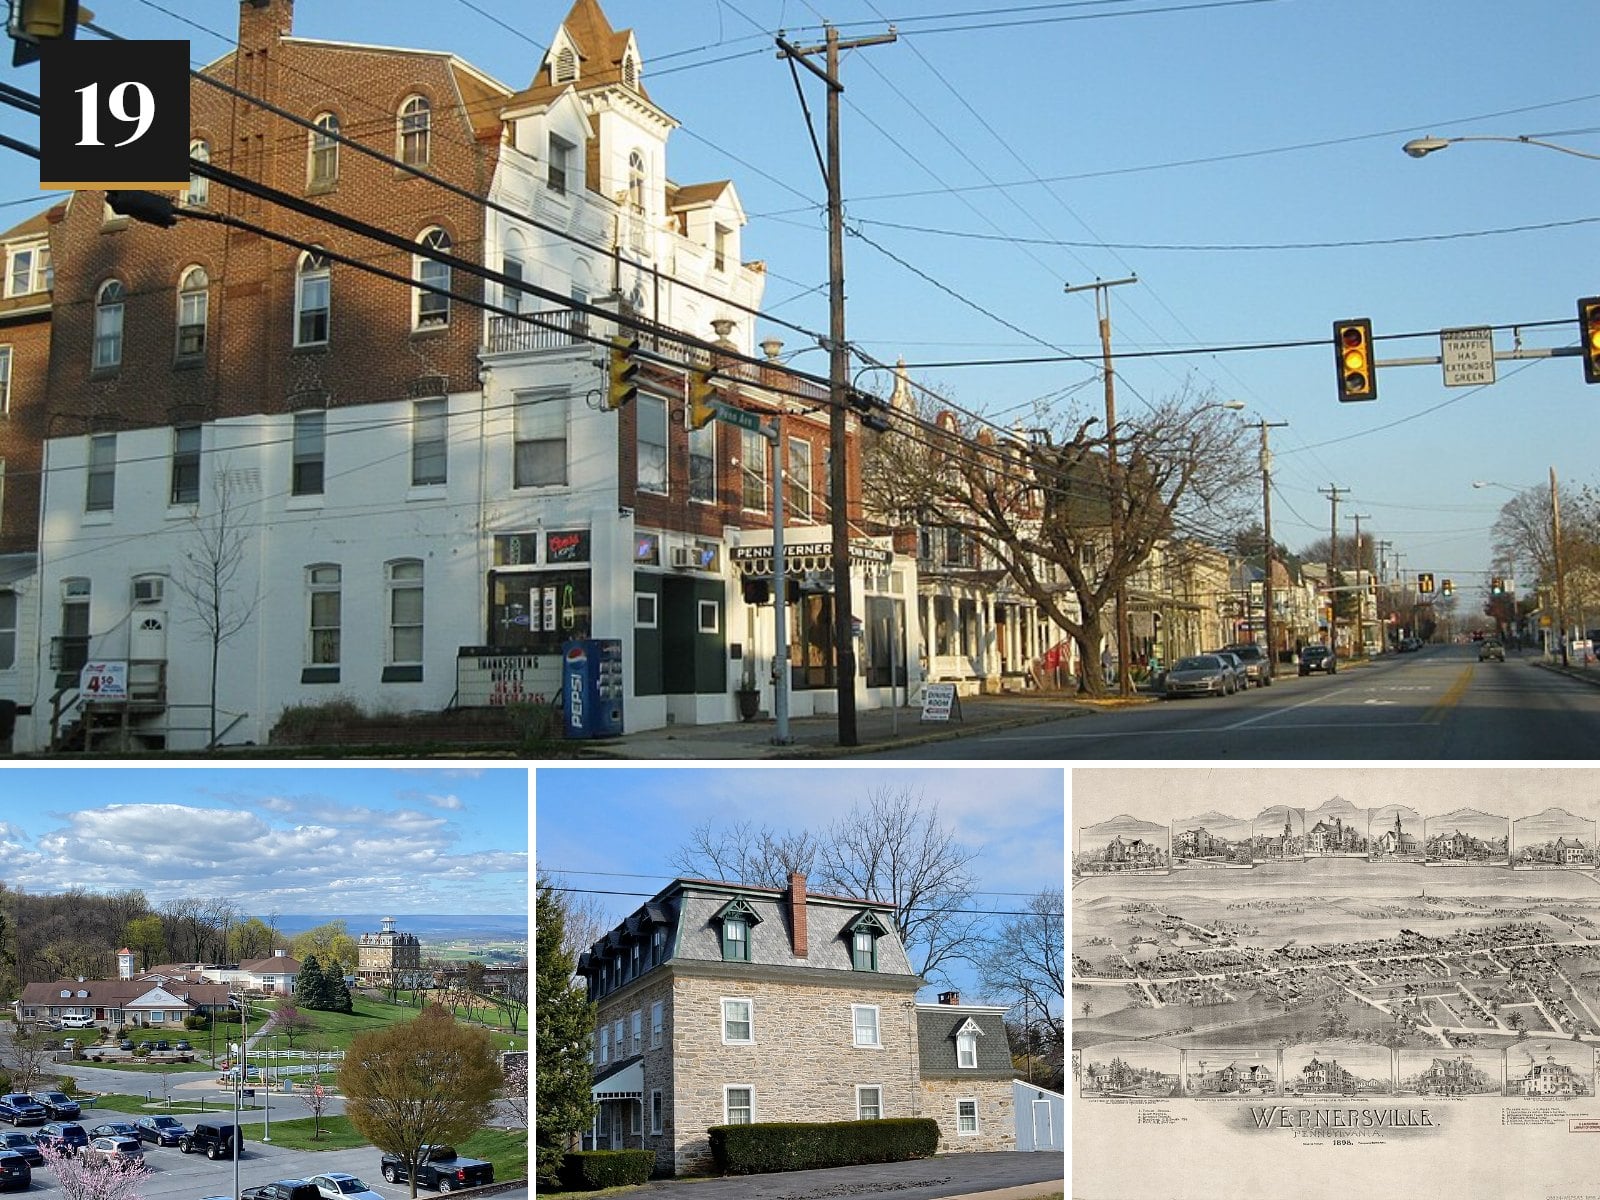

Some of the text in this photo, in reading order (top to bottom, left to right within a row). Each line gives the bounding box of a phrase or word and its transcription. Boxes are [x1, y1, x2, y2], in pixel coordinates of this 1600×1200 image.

[1447, 341, 1487, 351] TRAFFIC
[1457, 351, 1478, 360] HAS
[1446, 361, 1491, 372] EXTENDED
[1454, 373, 1484, 382] GREEN
[737, 547, 772, 558] PENN
[491, 668, 524, 681] BUFFET
[571, 674, 583, 728] PEPSI
